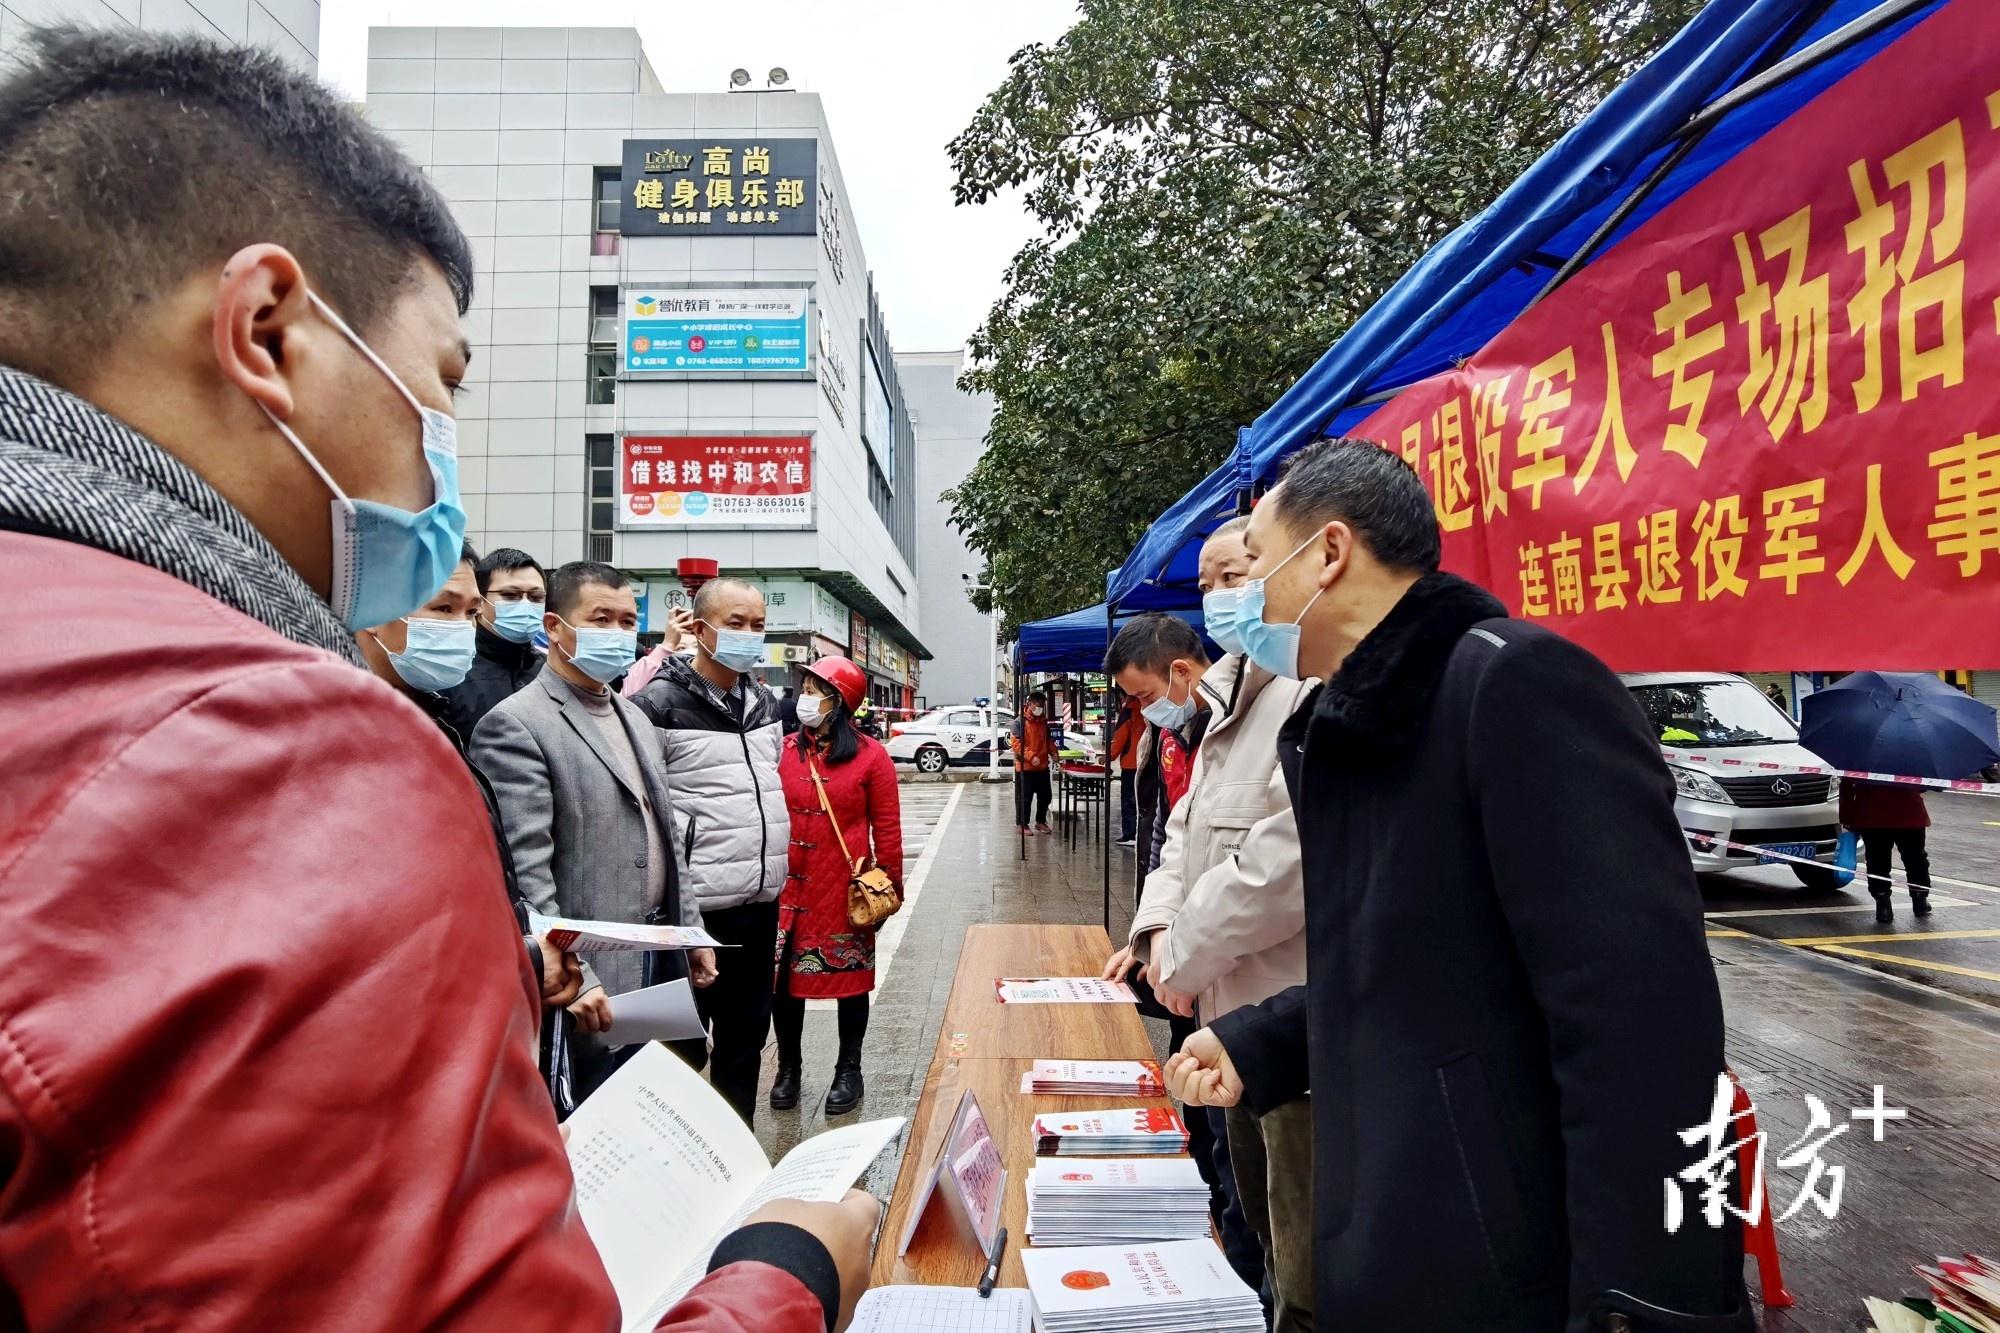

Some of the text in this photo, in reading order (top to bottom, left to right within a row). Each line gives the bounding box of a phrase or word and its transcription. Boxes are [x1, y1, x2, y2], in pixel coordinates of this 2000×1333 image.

[645, 149, 693, 168] Lofty
[702, 145, 770, 177] 高尚
[633, 178, 804, 209] 健身俱乐部
[659, 299, 711, 313] 誉优教育
[631, 460, 804, 485] 借钱找中和农信
[724, 497, 805, 507] 0763-8663016
[951, 732, 977, 744] 公安
